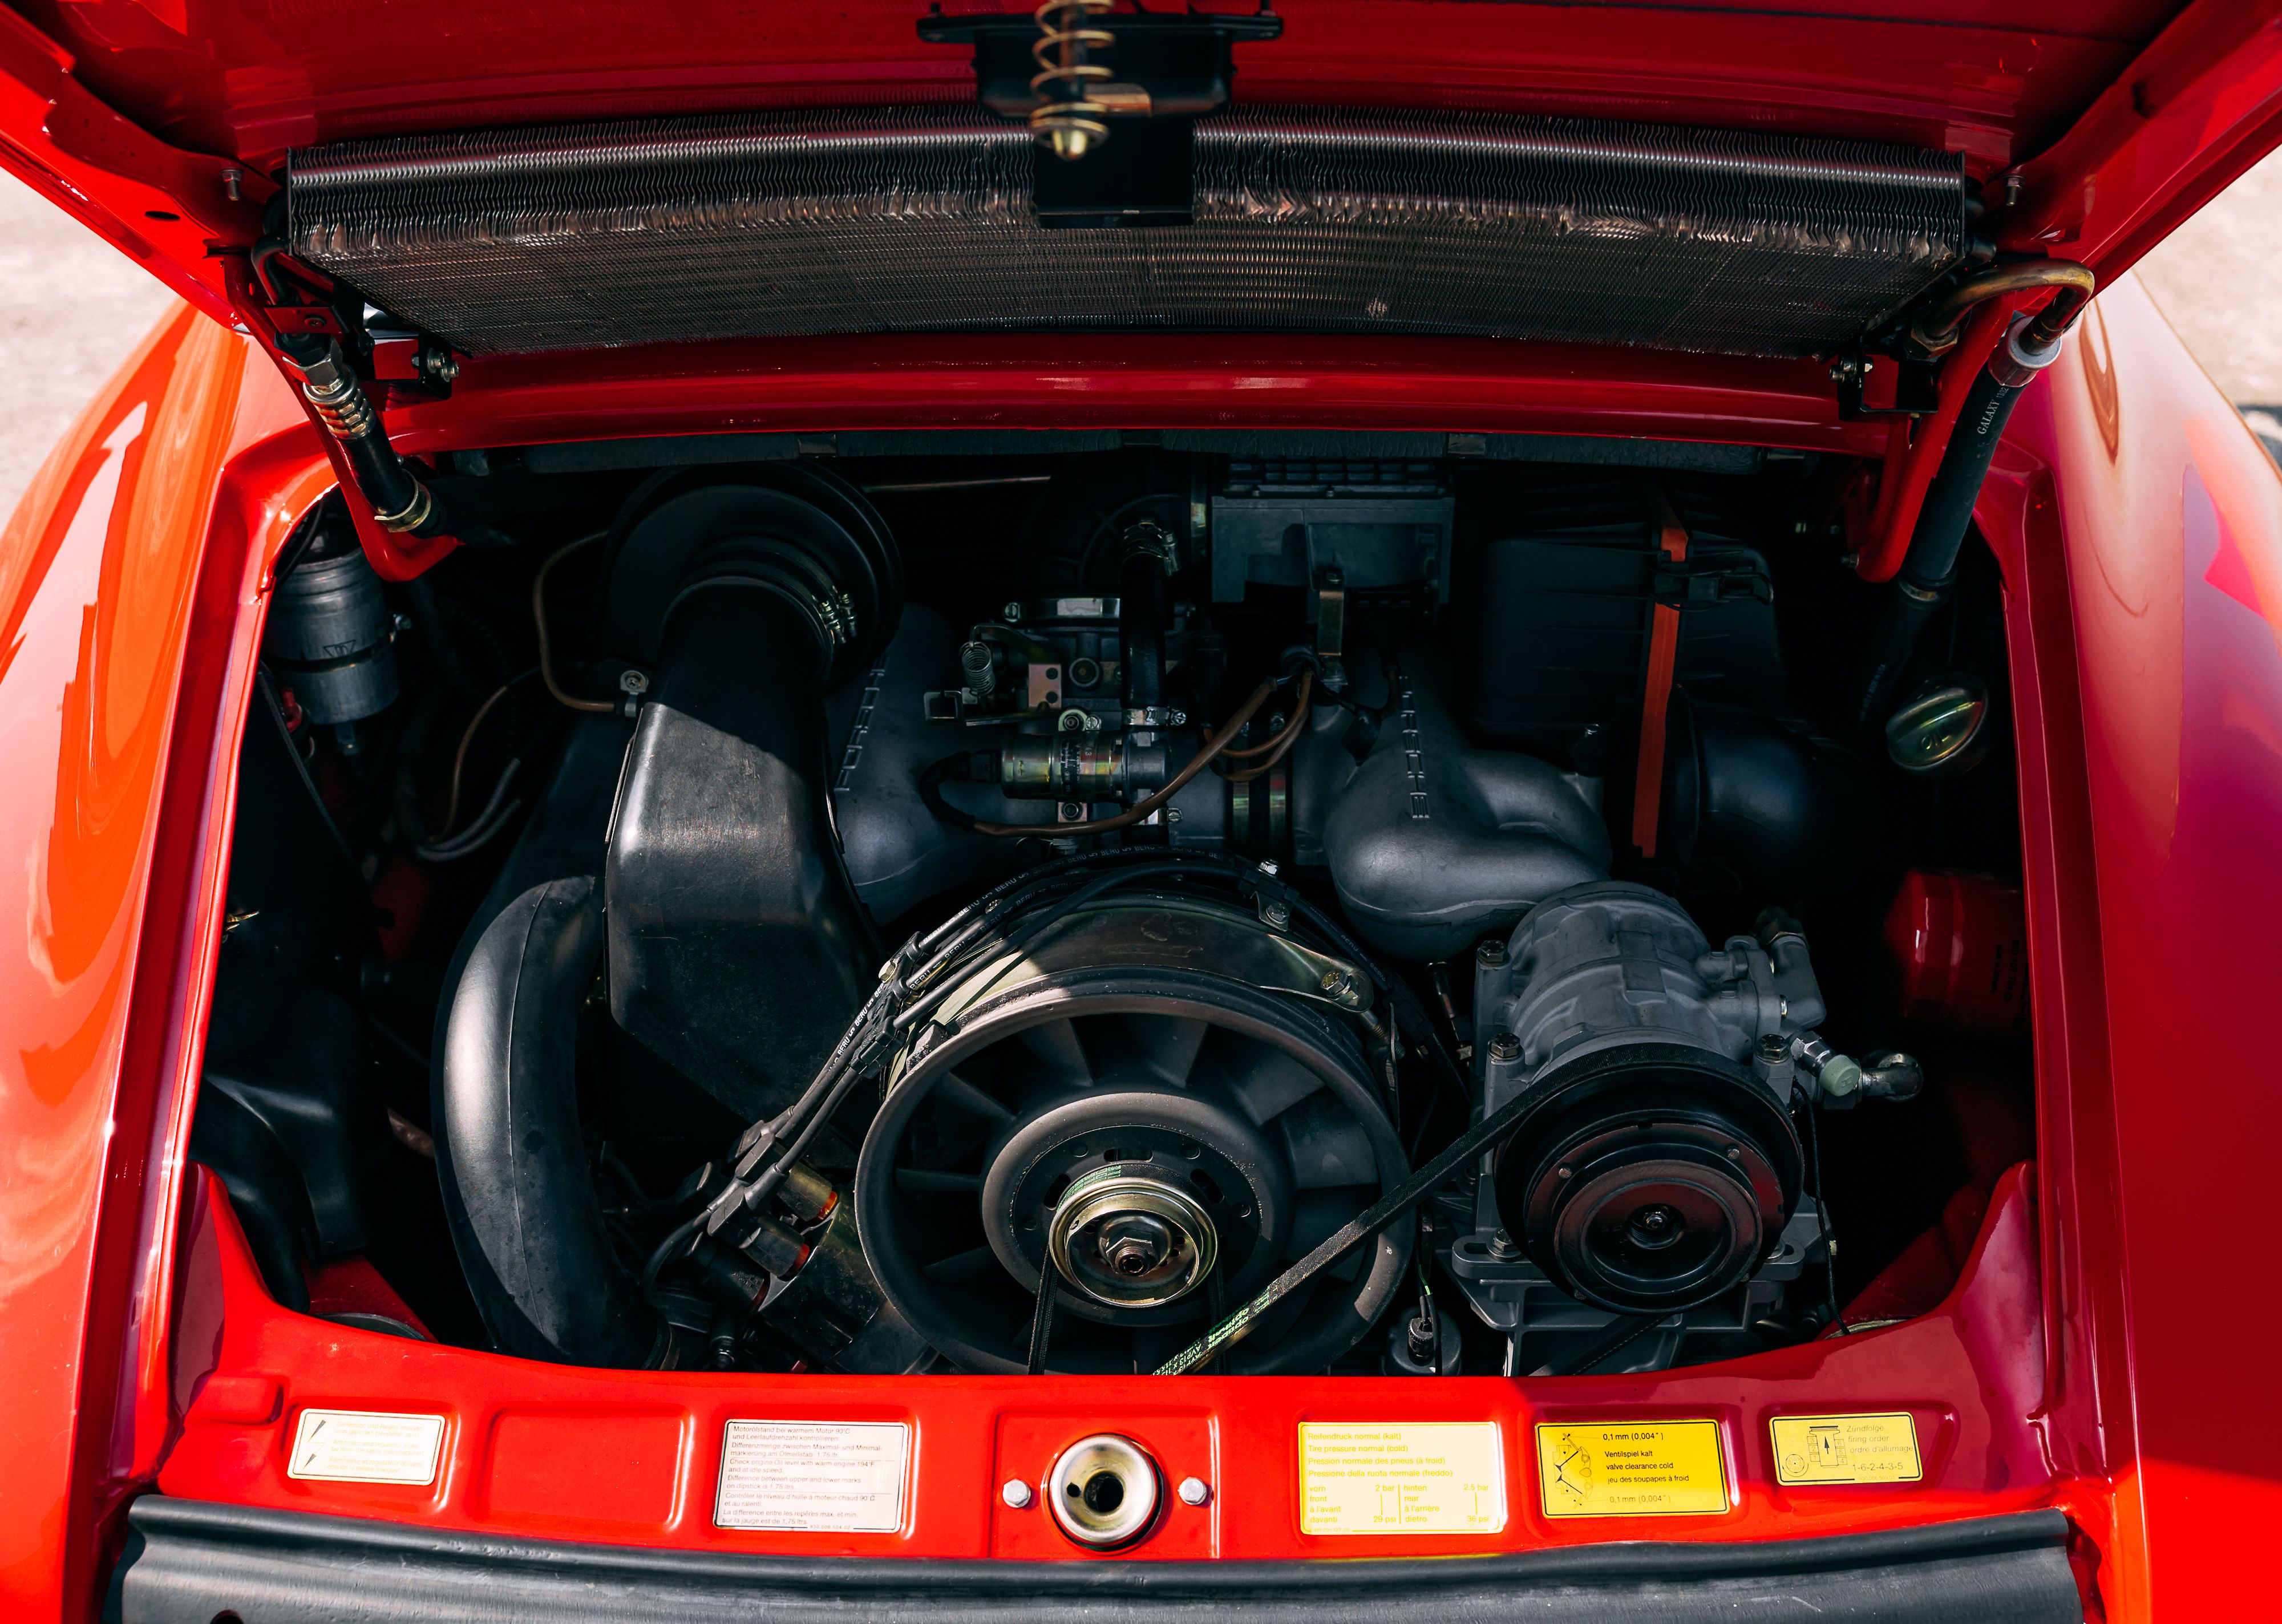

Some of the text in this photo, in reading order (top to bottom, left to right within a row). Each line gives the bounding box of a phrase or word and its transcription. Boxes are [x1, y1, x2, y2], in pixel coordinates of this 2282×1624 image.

[1977, 399, 2000, 434] GALAXY
[1921, 730, 1952, 750] OIL
[910, 892, 1036, 990] BERU BERU BERU BERU
[837, 1036, 851, 1056] BERU
[854, 1007, 868, 1027] BERU
[958, 900, 980, 917] BERU
[995, 878, 1017, 892] BERU
[1067, 853, 1087, 863] BERU
[1178, 1343, 1201, 1366] AVP13
[1852, 1462, 1903, 1471] 1-6-2-4-3-5
[1467, 1515, 1476, 1524] 36
